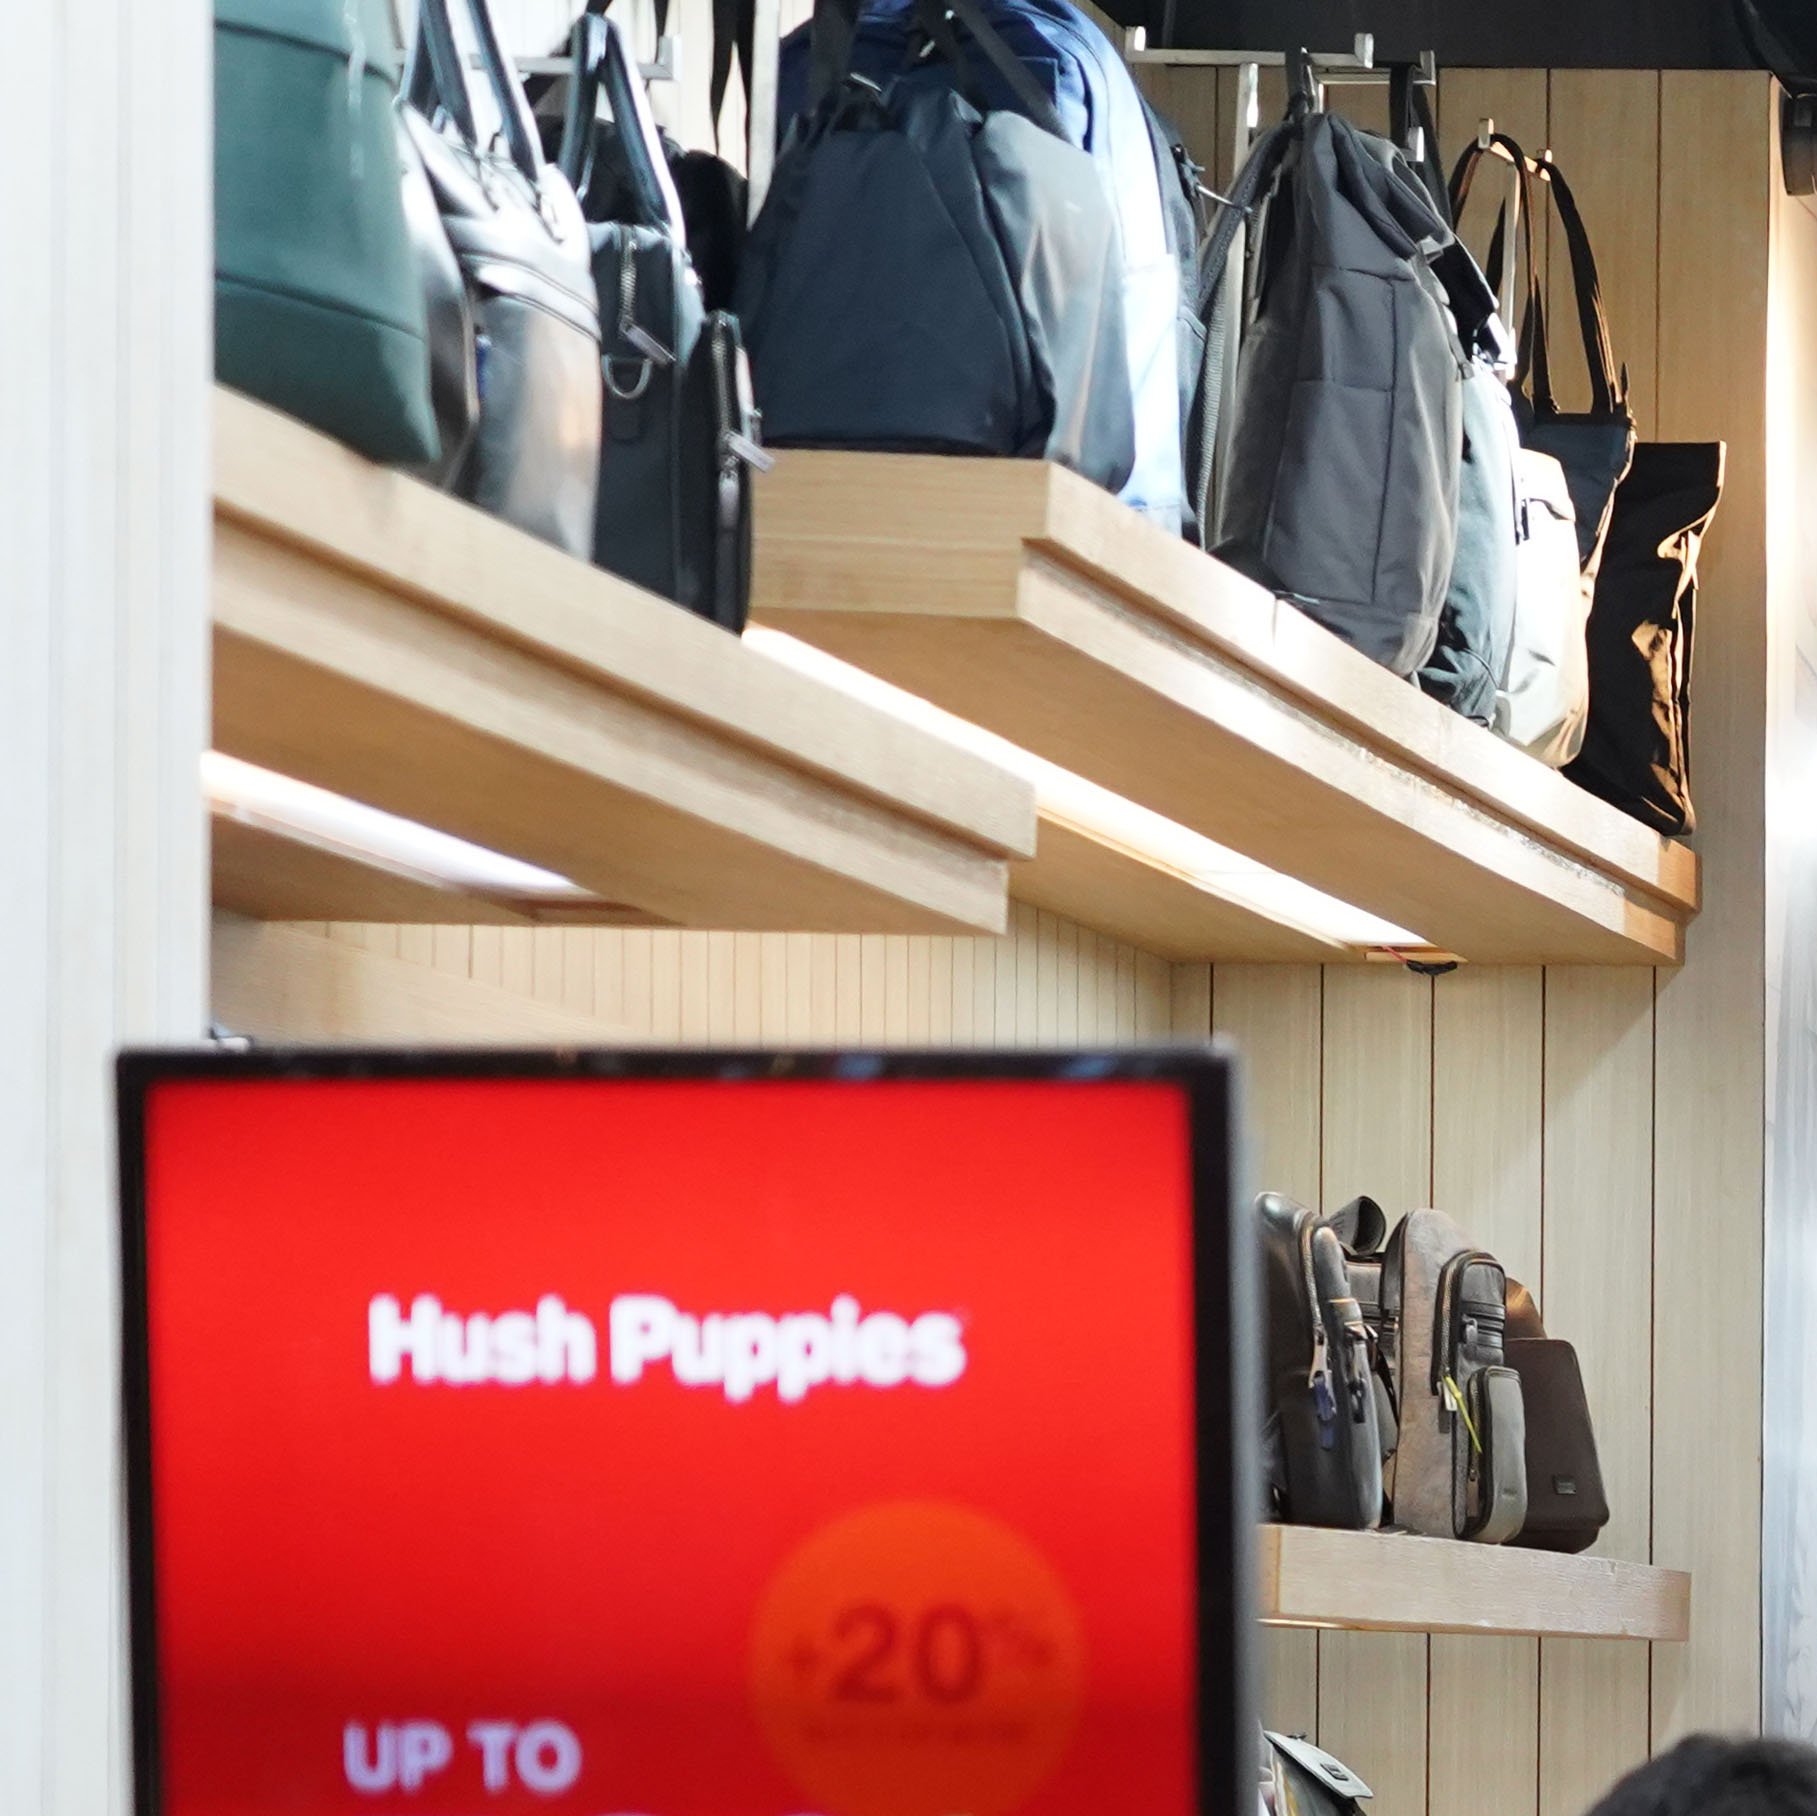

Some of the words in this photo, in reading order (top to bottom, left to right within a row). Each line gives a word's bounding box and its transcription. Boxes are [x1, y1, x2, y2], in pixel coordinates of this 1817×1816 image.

[367, 1293, 598, 1386] Hush
[608, 1293, 967, 1403] Puppies
[345, 1726, 449, 1788] UP
[473, 1725, 580, 1791] TO
